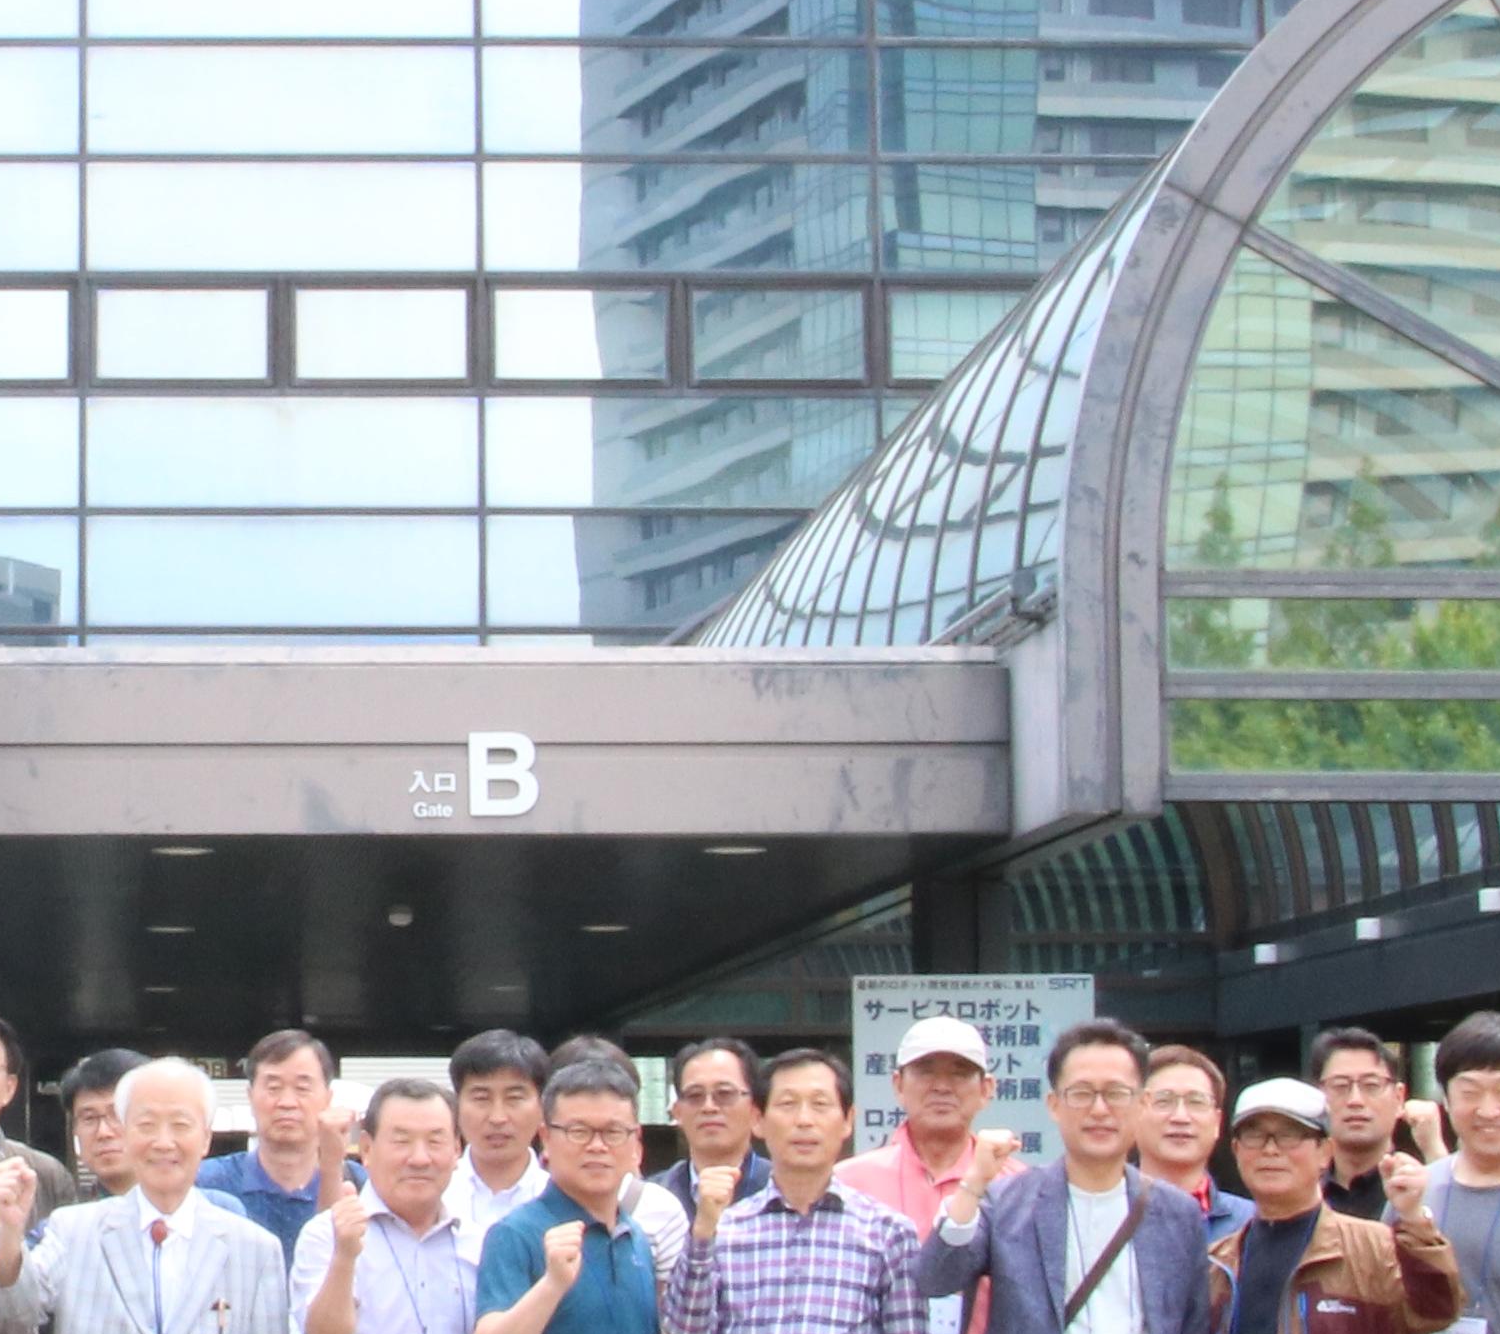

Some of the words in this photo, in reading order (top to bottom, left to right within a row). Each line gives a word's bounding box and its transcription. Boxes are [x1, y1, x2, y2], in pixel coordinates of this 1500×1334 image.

[408, 770, 456, 793] 入口
[468, 731, 539, 816] B
[412, 802, 454, 818] Gate
[1048, 977, 1092, 991] SRT
[864, 998, 1041, 1020] サービスロボット
